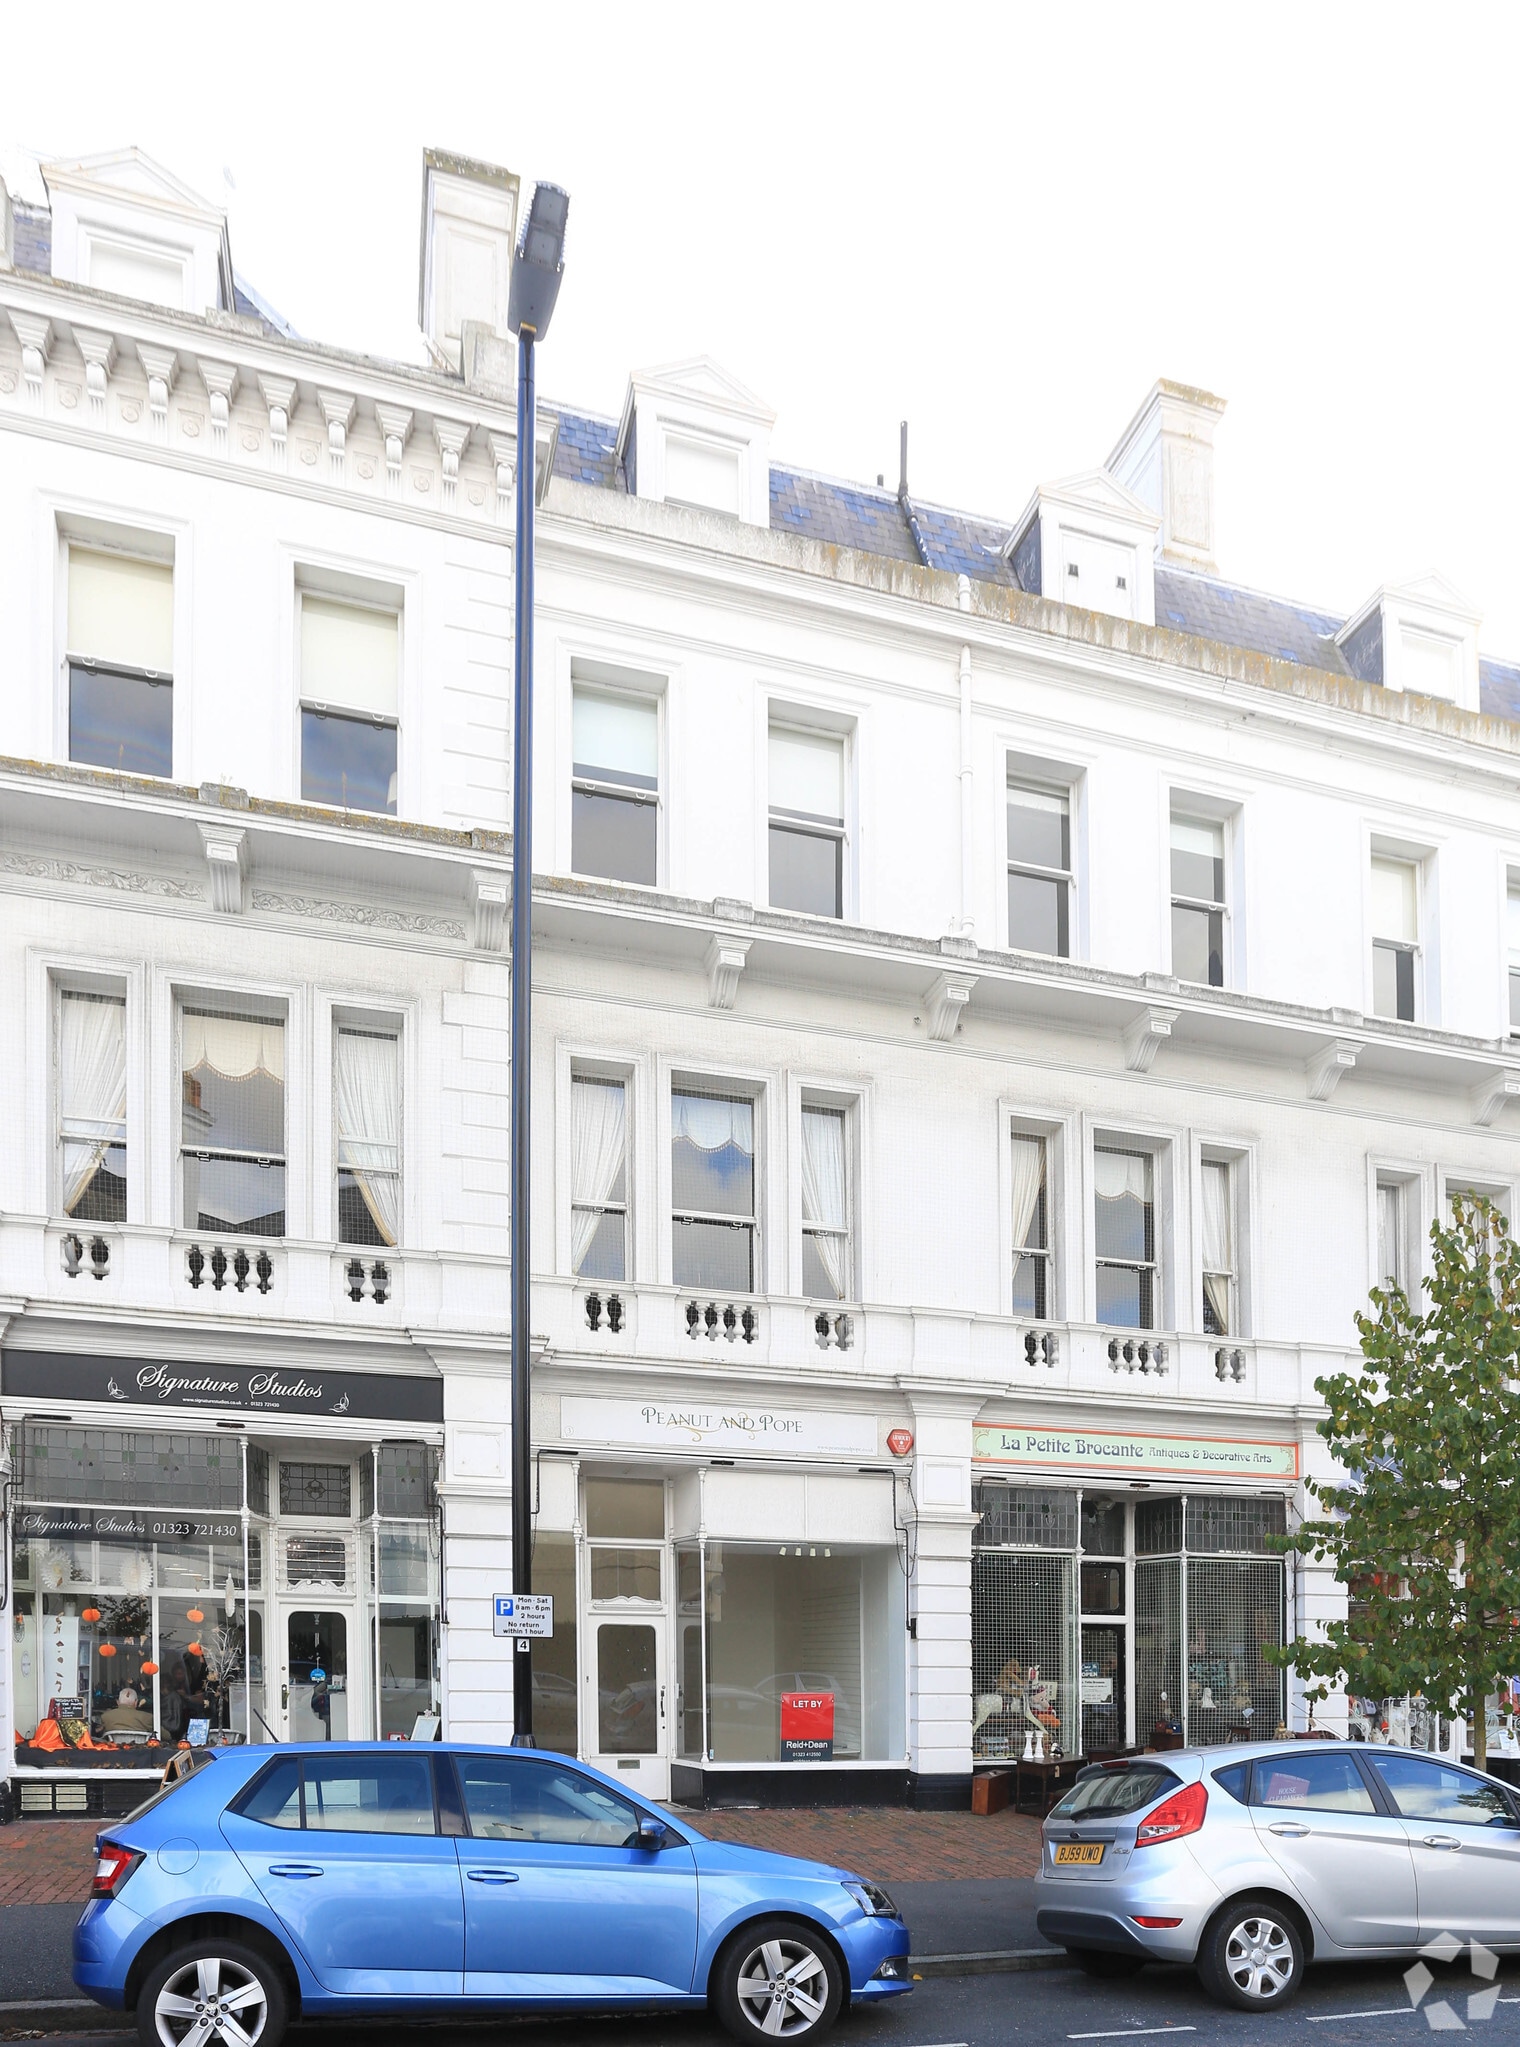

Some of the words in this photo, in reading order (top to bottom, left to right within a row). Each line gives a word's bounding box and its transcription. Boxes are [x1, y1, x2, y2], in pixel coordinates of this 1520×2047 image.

[136, 1364, 240, 1399] Signature
[248, 1371, 323, 1399] Studios
[641, 1406, 713, 1428] PEANUT
[718, 1415, 755, 1430] AND
[758, 1414, 804, 1433] POPE
[1000, 1434, 1021, 1451] La
[1025, 1436, 1070, 1454] Petite
[1074, 1438, 1144, 1458] Brocante
[1149, 1446, 1190, 1459] Antiques
[1193, 1449, 1200, 1459] &
[1202, 1450, 1251, 1463] Decorative
[1253, 1452, 1273, 1464] Arts
[22, 1513, 92, 1536] Signature
[95, 1516, 146, 1535] Studios
[152, 1521, 191, 1535] 01323
[193, 1524, 238, 1537] 721430
[520, 1640, 527, 1650] 4
[792, 1700, 809, 1708] LET
[810, 1700, 822, 1708] BY
[786, 1740, 828, 1749] Reid+Dean
[1058, 1846, 1082, 1861] BJ59
